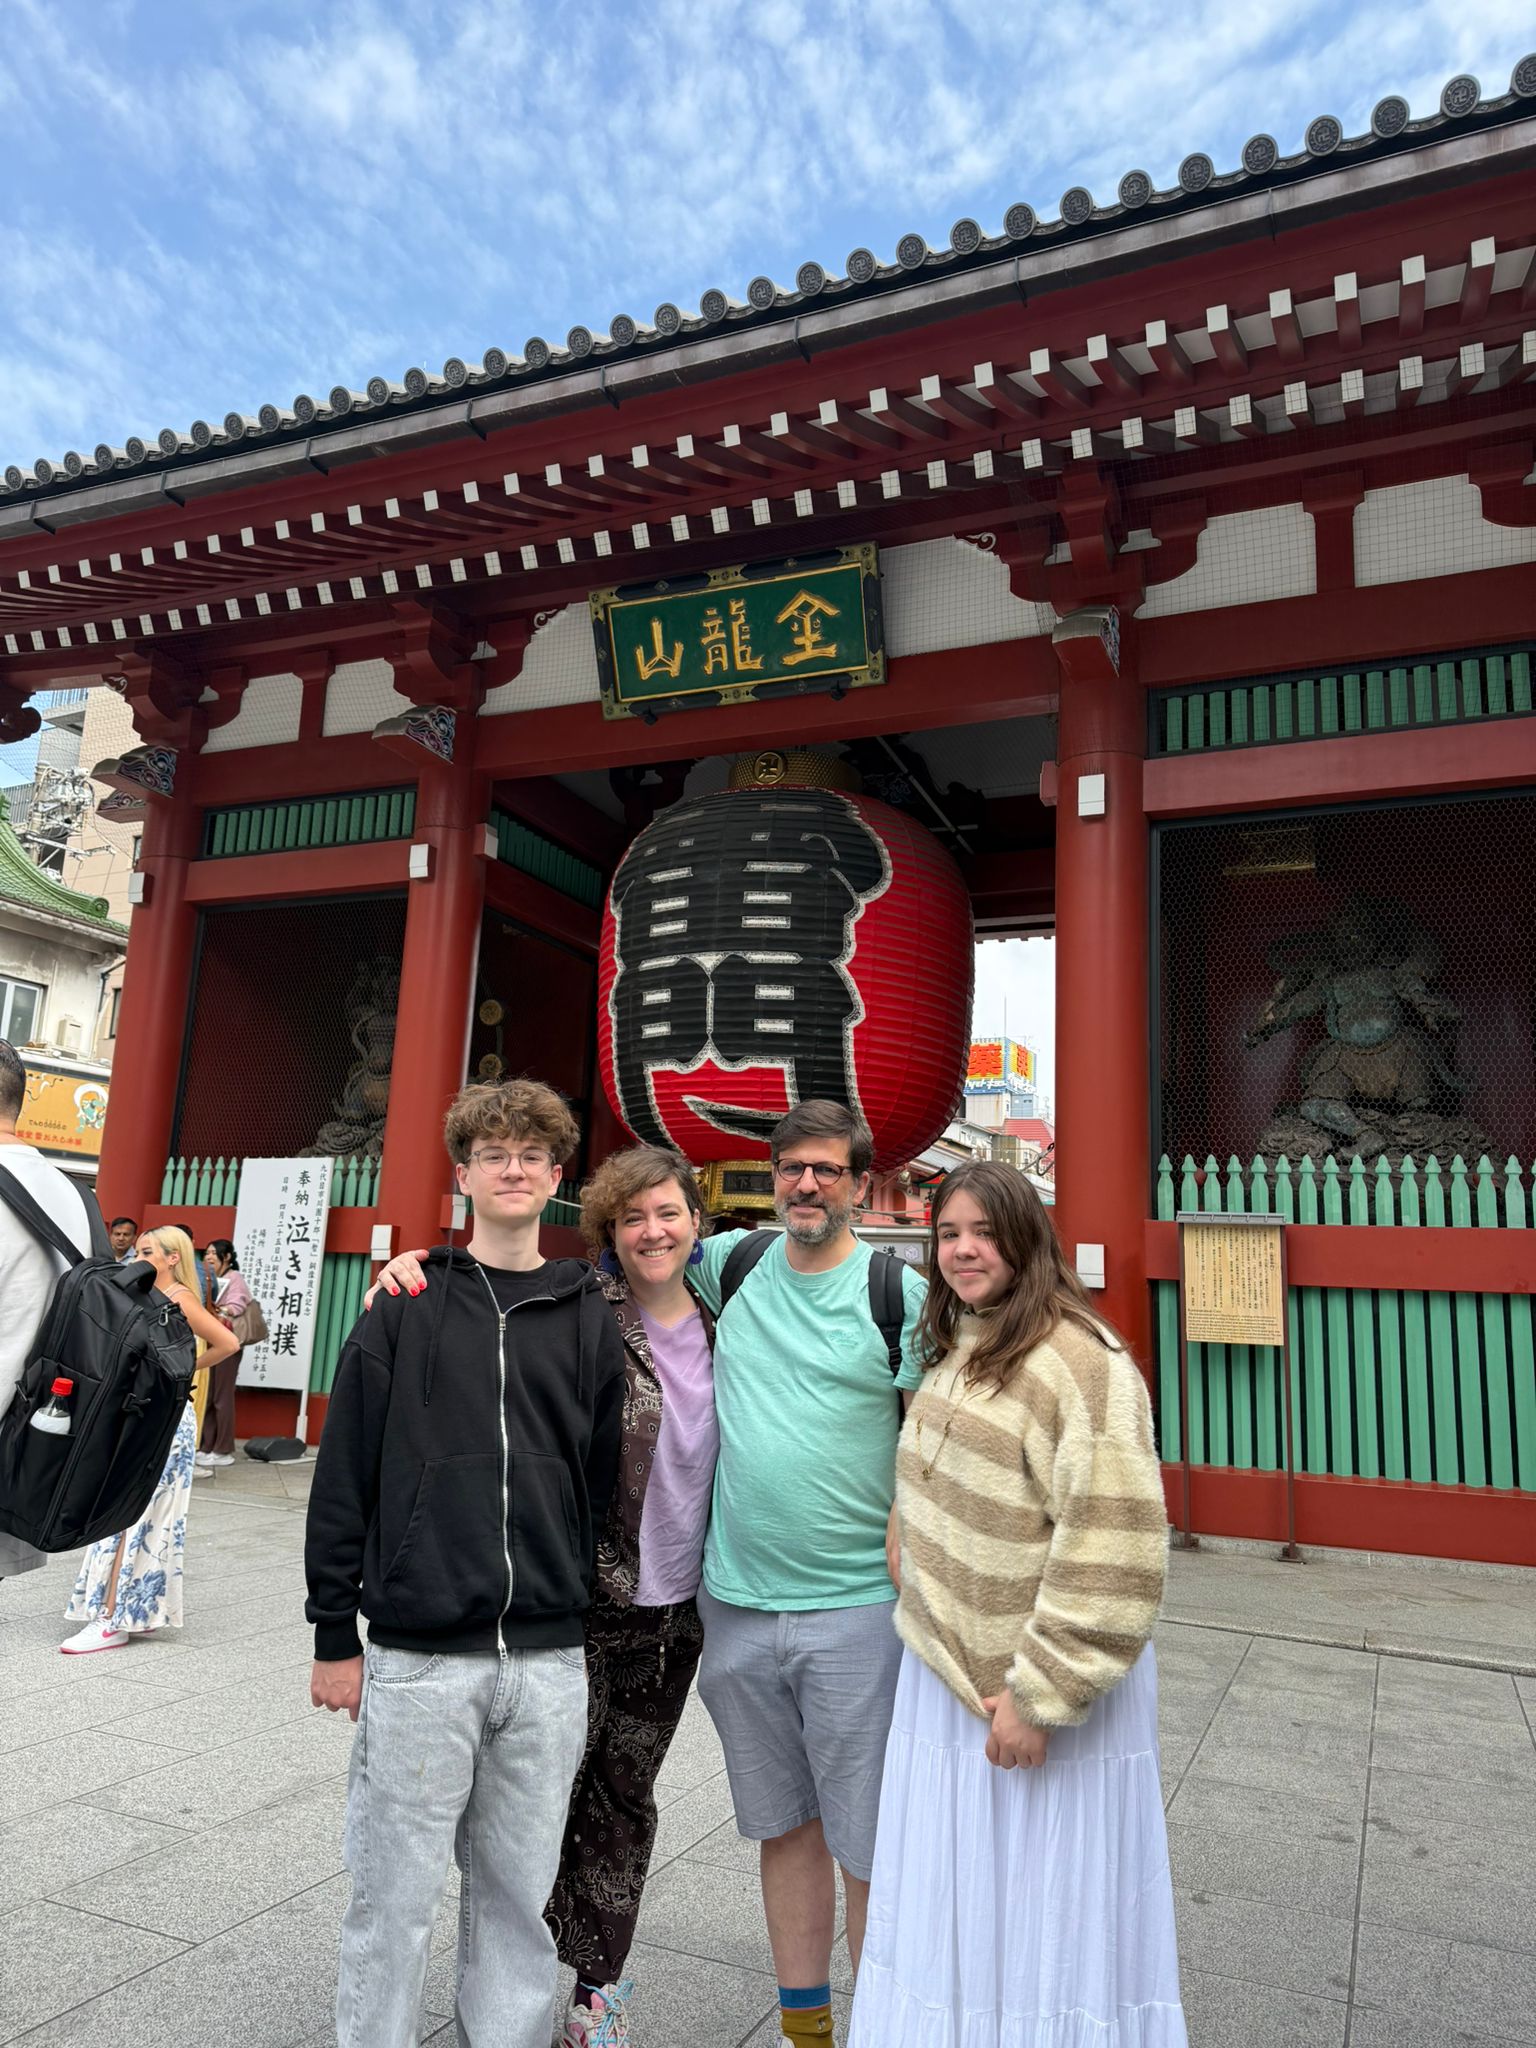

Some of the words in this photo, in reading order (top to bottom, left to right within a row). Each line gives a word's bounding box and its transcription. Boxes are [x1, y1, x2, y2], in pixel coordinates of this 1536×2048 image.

[967, 1043, 1002, 1077] 薬
[295, 1170, 312, 1206] 奉納
[272, 1215, 311, 1356] 泣き相撲
